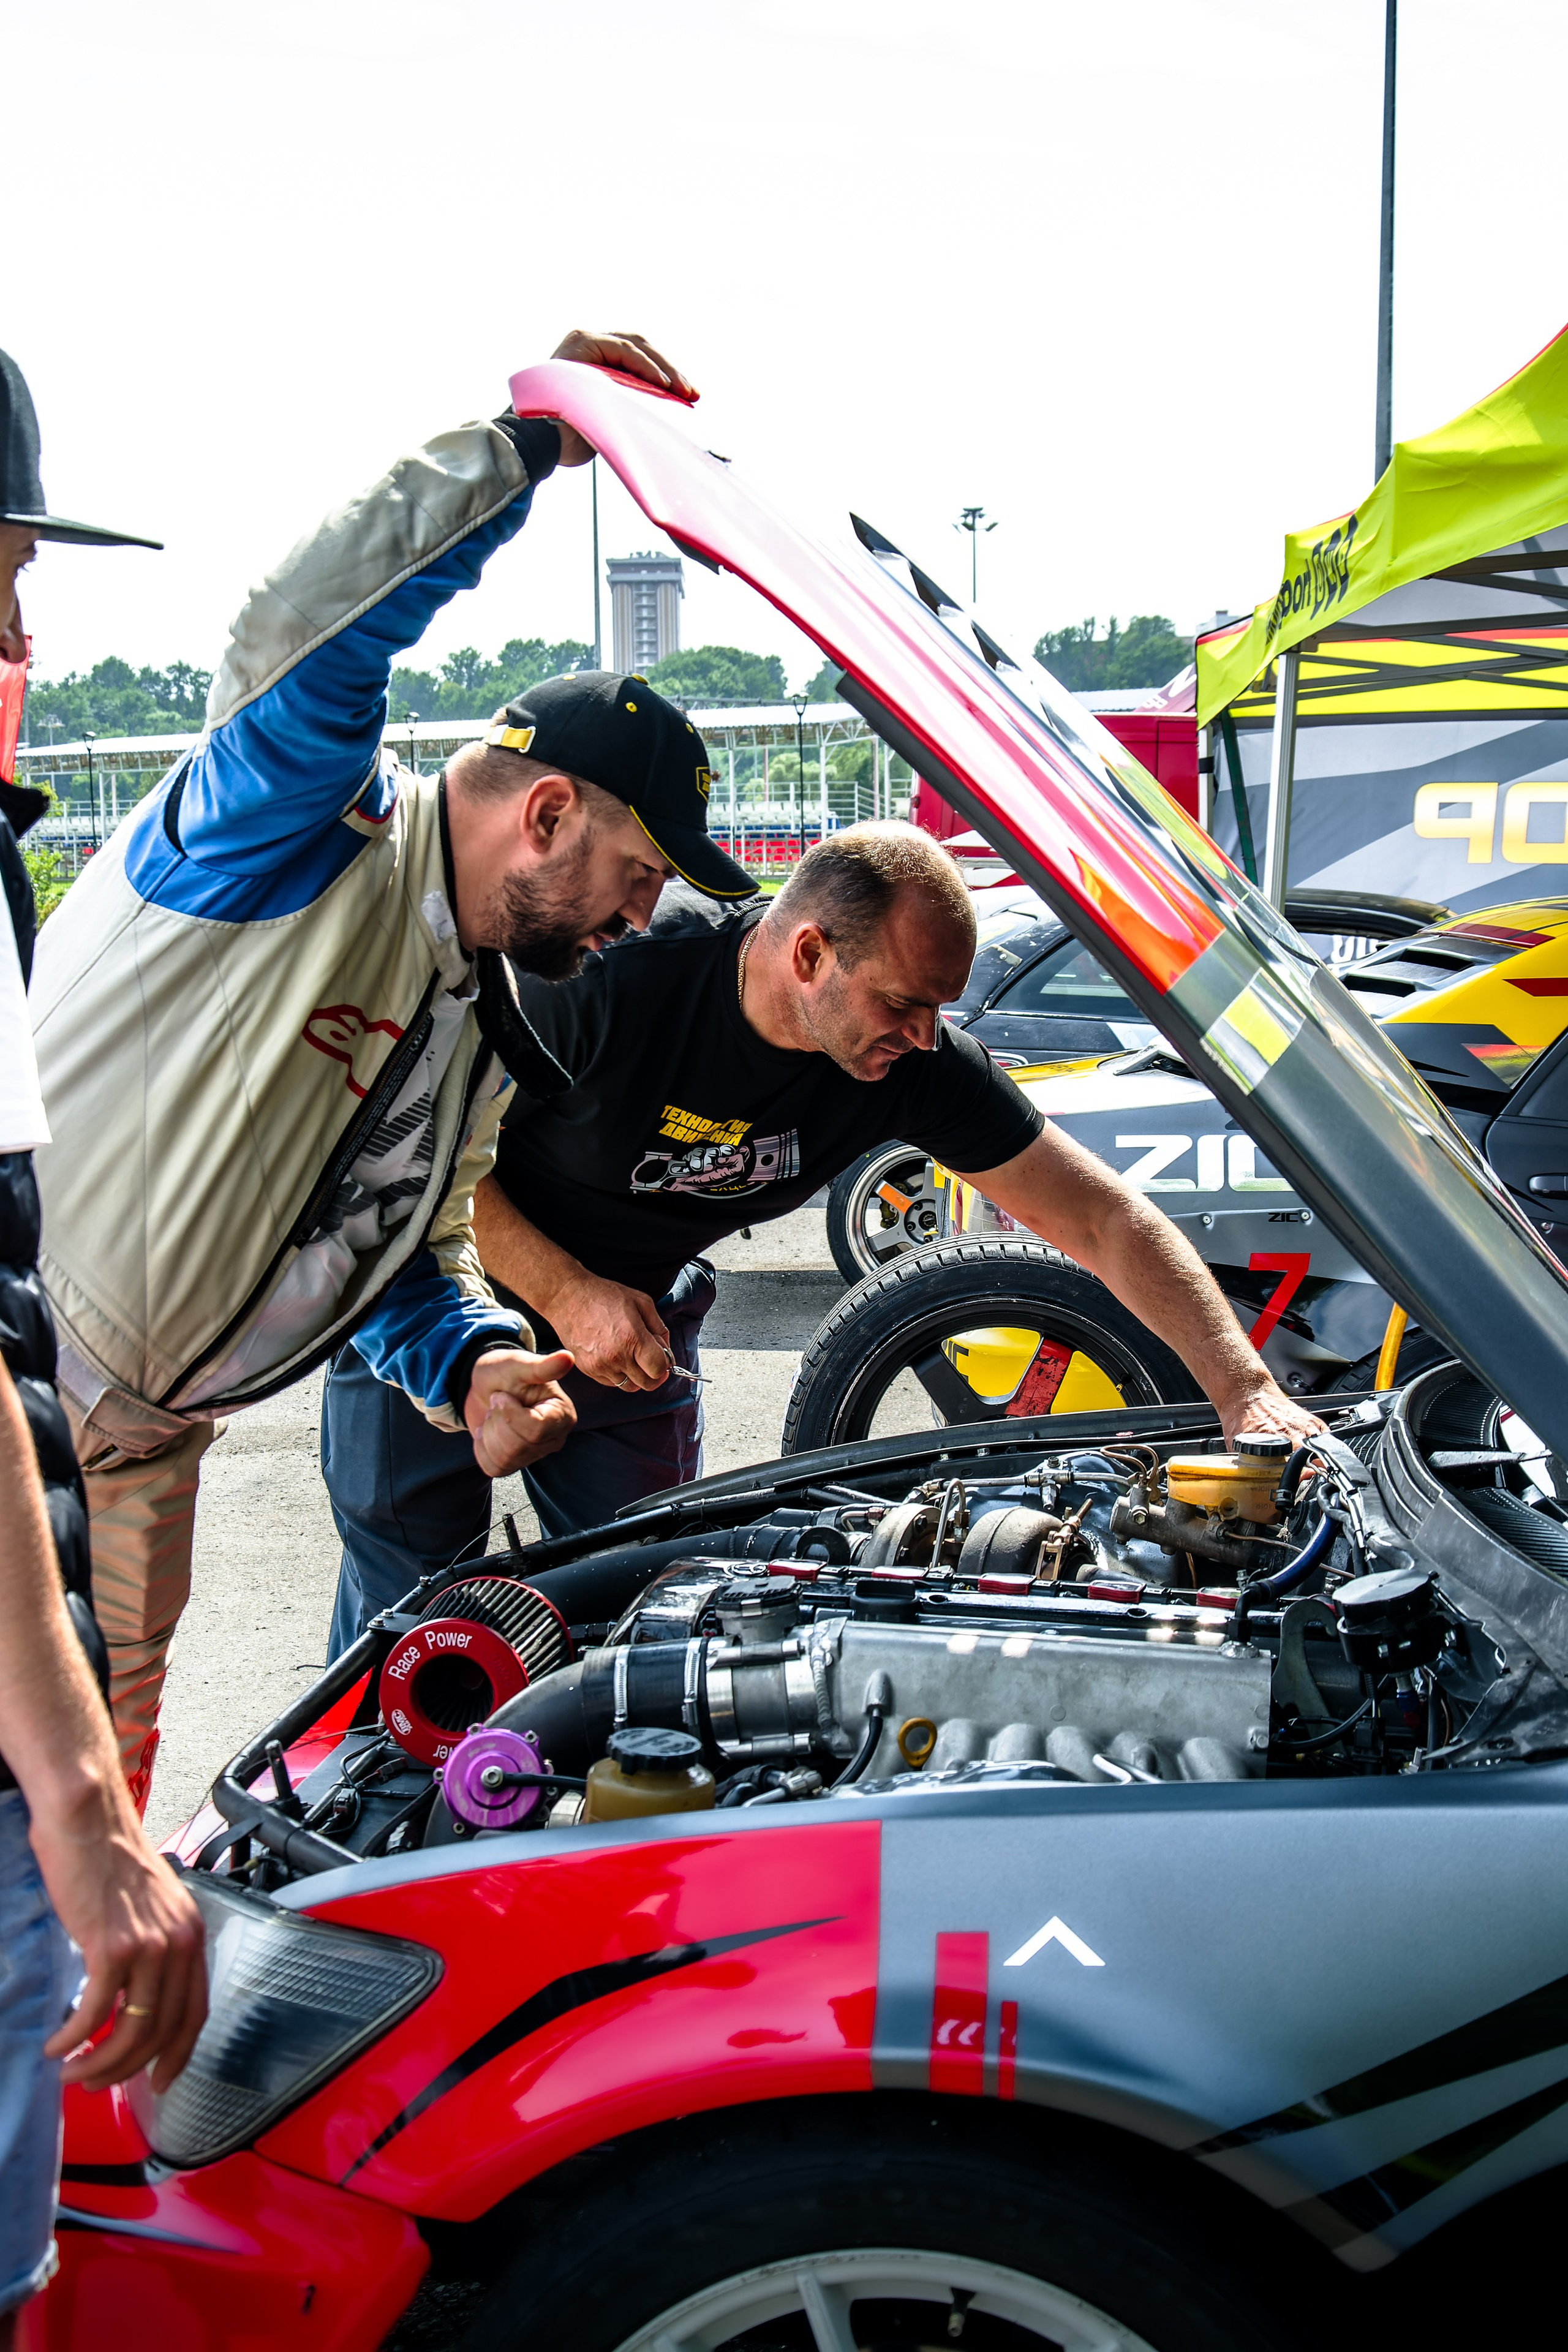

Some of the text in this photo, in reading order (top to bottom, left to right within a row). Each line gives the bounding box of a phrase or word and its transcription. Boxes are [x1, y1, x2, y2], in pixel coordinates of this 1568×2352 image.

[660, 1104, 753, 1133] ТЕХНОЛГИЯ
[1115, 1134, 1295, 1192] ZIC
[1268, 1212, 1298, 1223] ZIC
[1248, 1253, 1311, 1351] 7
[388, 1630, 473, 1681] Race Power
